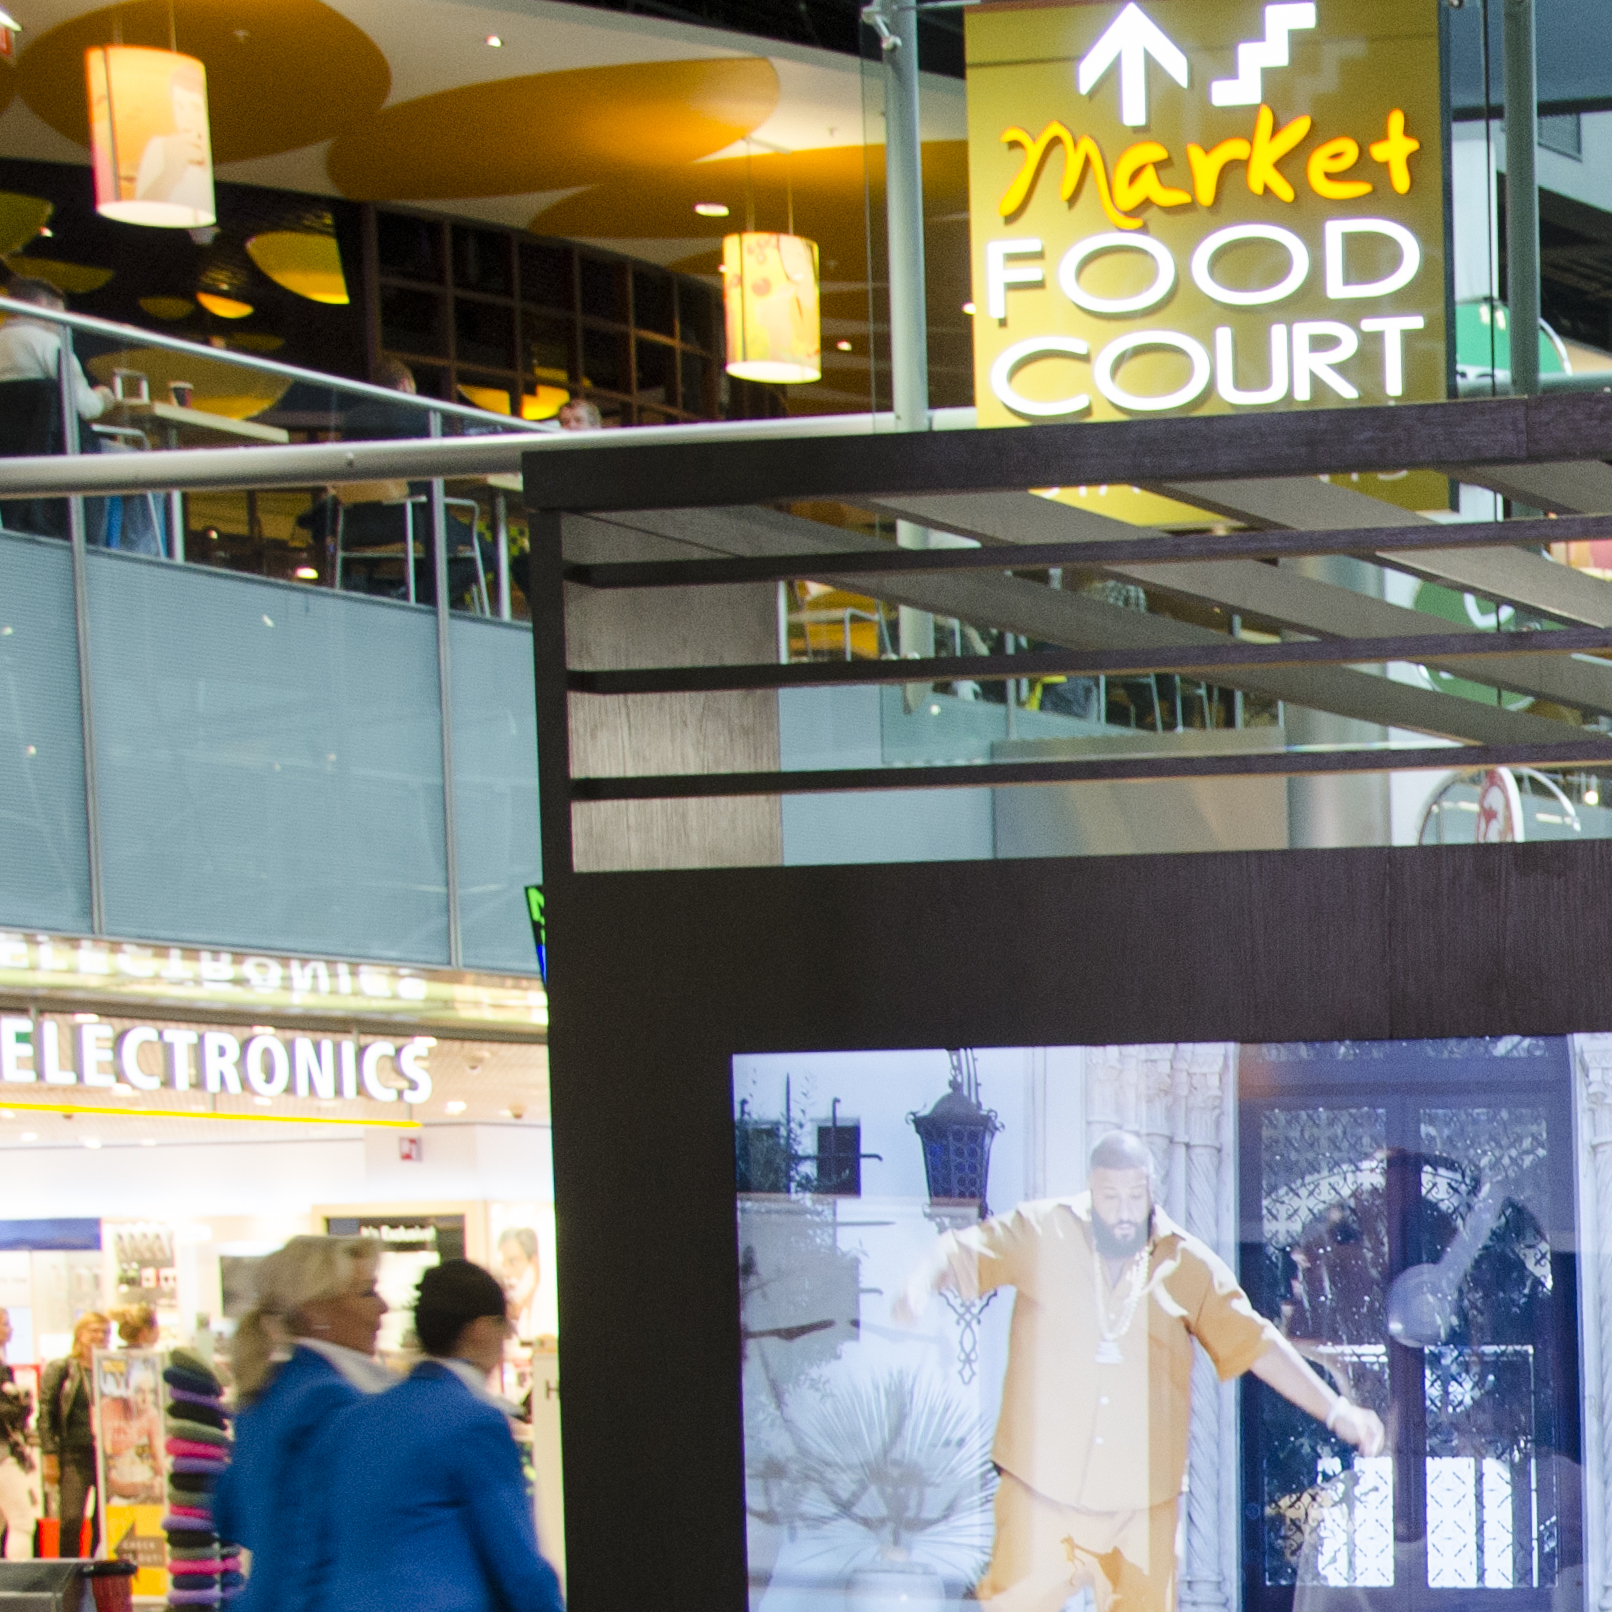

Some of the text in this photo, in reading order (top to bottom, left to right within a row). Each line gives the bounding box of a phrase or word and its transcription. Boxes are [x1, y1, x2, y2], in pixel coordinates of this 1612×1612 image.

[998, 103, 1420, 230] Market
[986, 218, 1421, 319] FOOD
[991, 315, 1425, 416] COURT
[0, 1017, 433, 1104] ELECTRONICS
